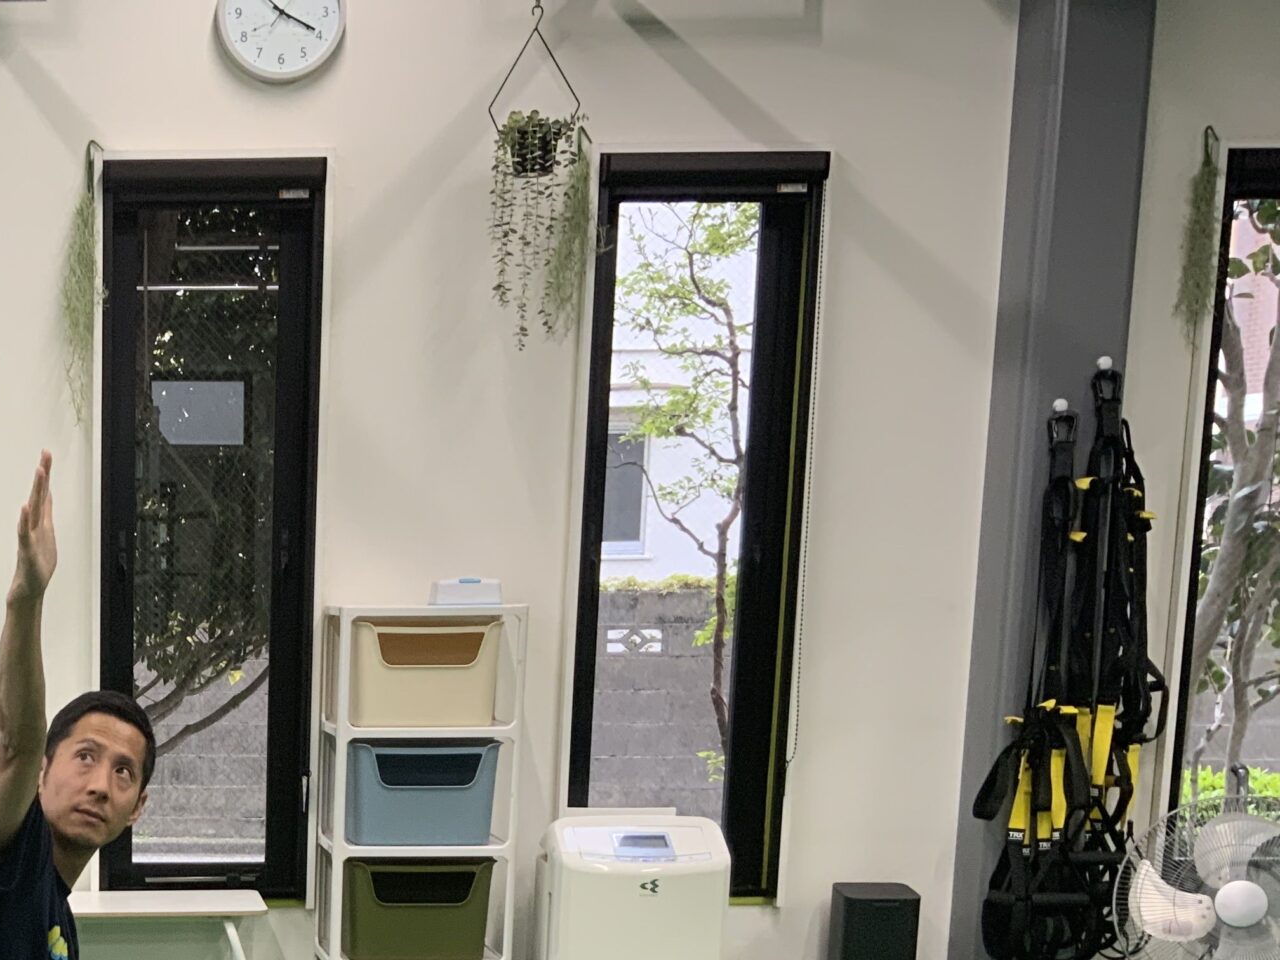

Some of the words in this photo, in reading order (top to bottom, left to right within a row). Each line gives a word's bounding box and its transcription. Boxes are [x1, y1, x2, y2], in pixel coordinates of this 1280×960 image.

[234, 7, 243, 19] 9
[322, 6, 329, 18] 3
[240, 31, 248, 43] 8
[315, 30, 323, 41] 4
[256, 47, 263, 59] 7
[300, 46, 307, 58] 5
[277, 53, 285, 65] 6
